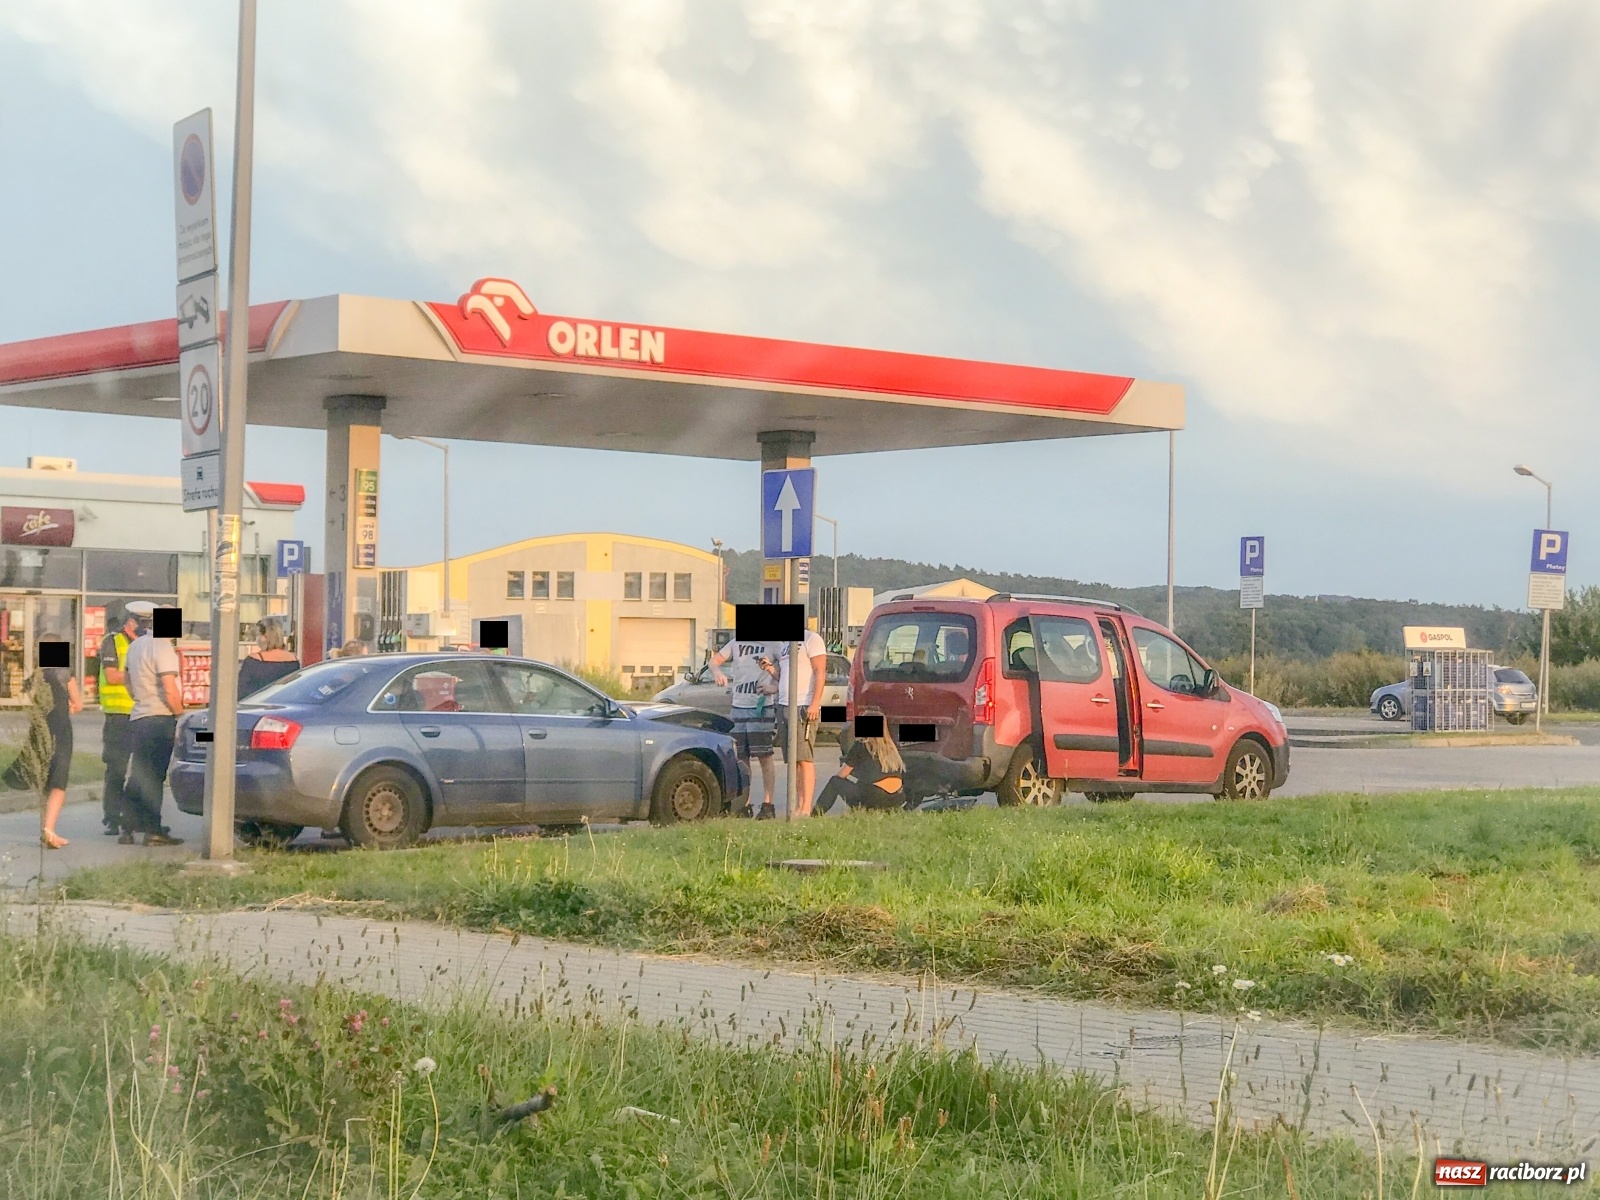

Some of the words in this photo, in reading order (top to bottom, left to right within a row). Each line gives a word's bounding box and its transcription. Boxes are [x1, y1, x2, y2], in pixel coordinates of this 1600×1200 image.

[548, 320, 665, 364] ORLEN
[190, 383, 209, 418] 20
[363, 481, 375, 492] 95
[362, 530, 374, 540] 98
[1540, 533, 1561, 560] P
[283, 543, 299, 567] P
[1246, 540, 1260, 565] P
[1428, 633, 1453, 641] GASPOL
[738, 643, 765, 657] YOU
